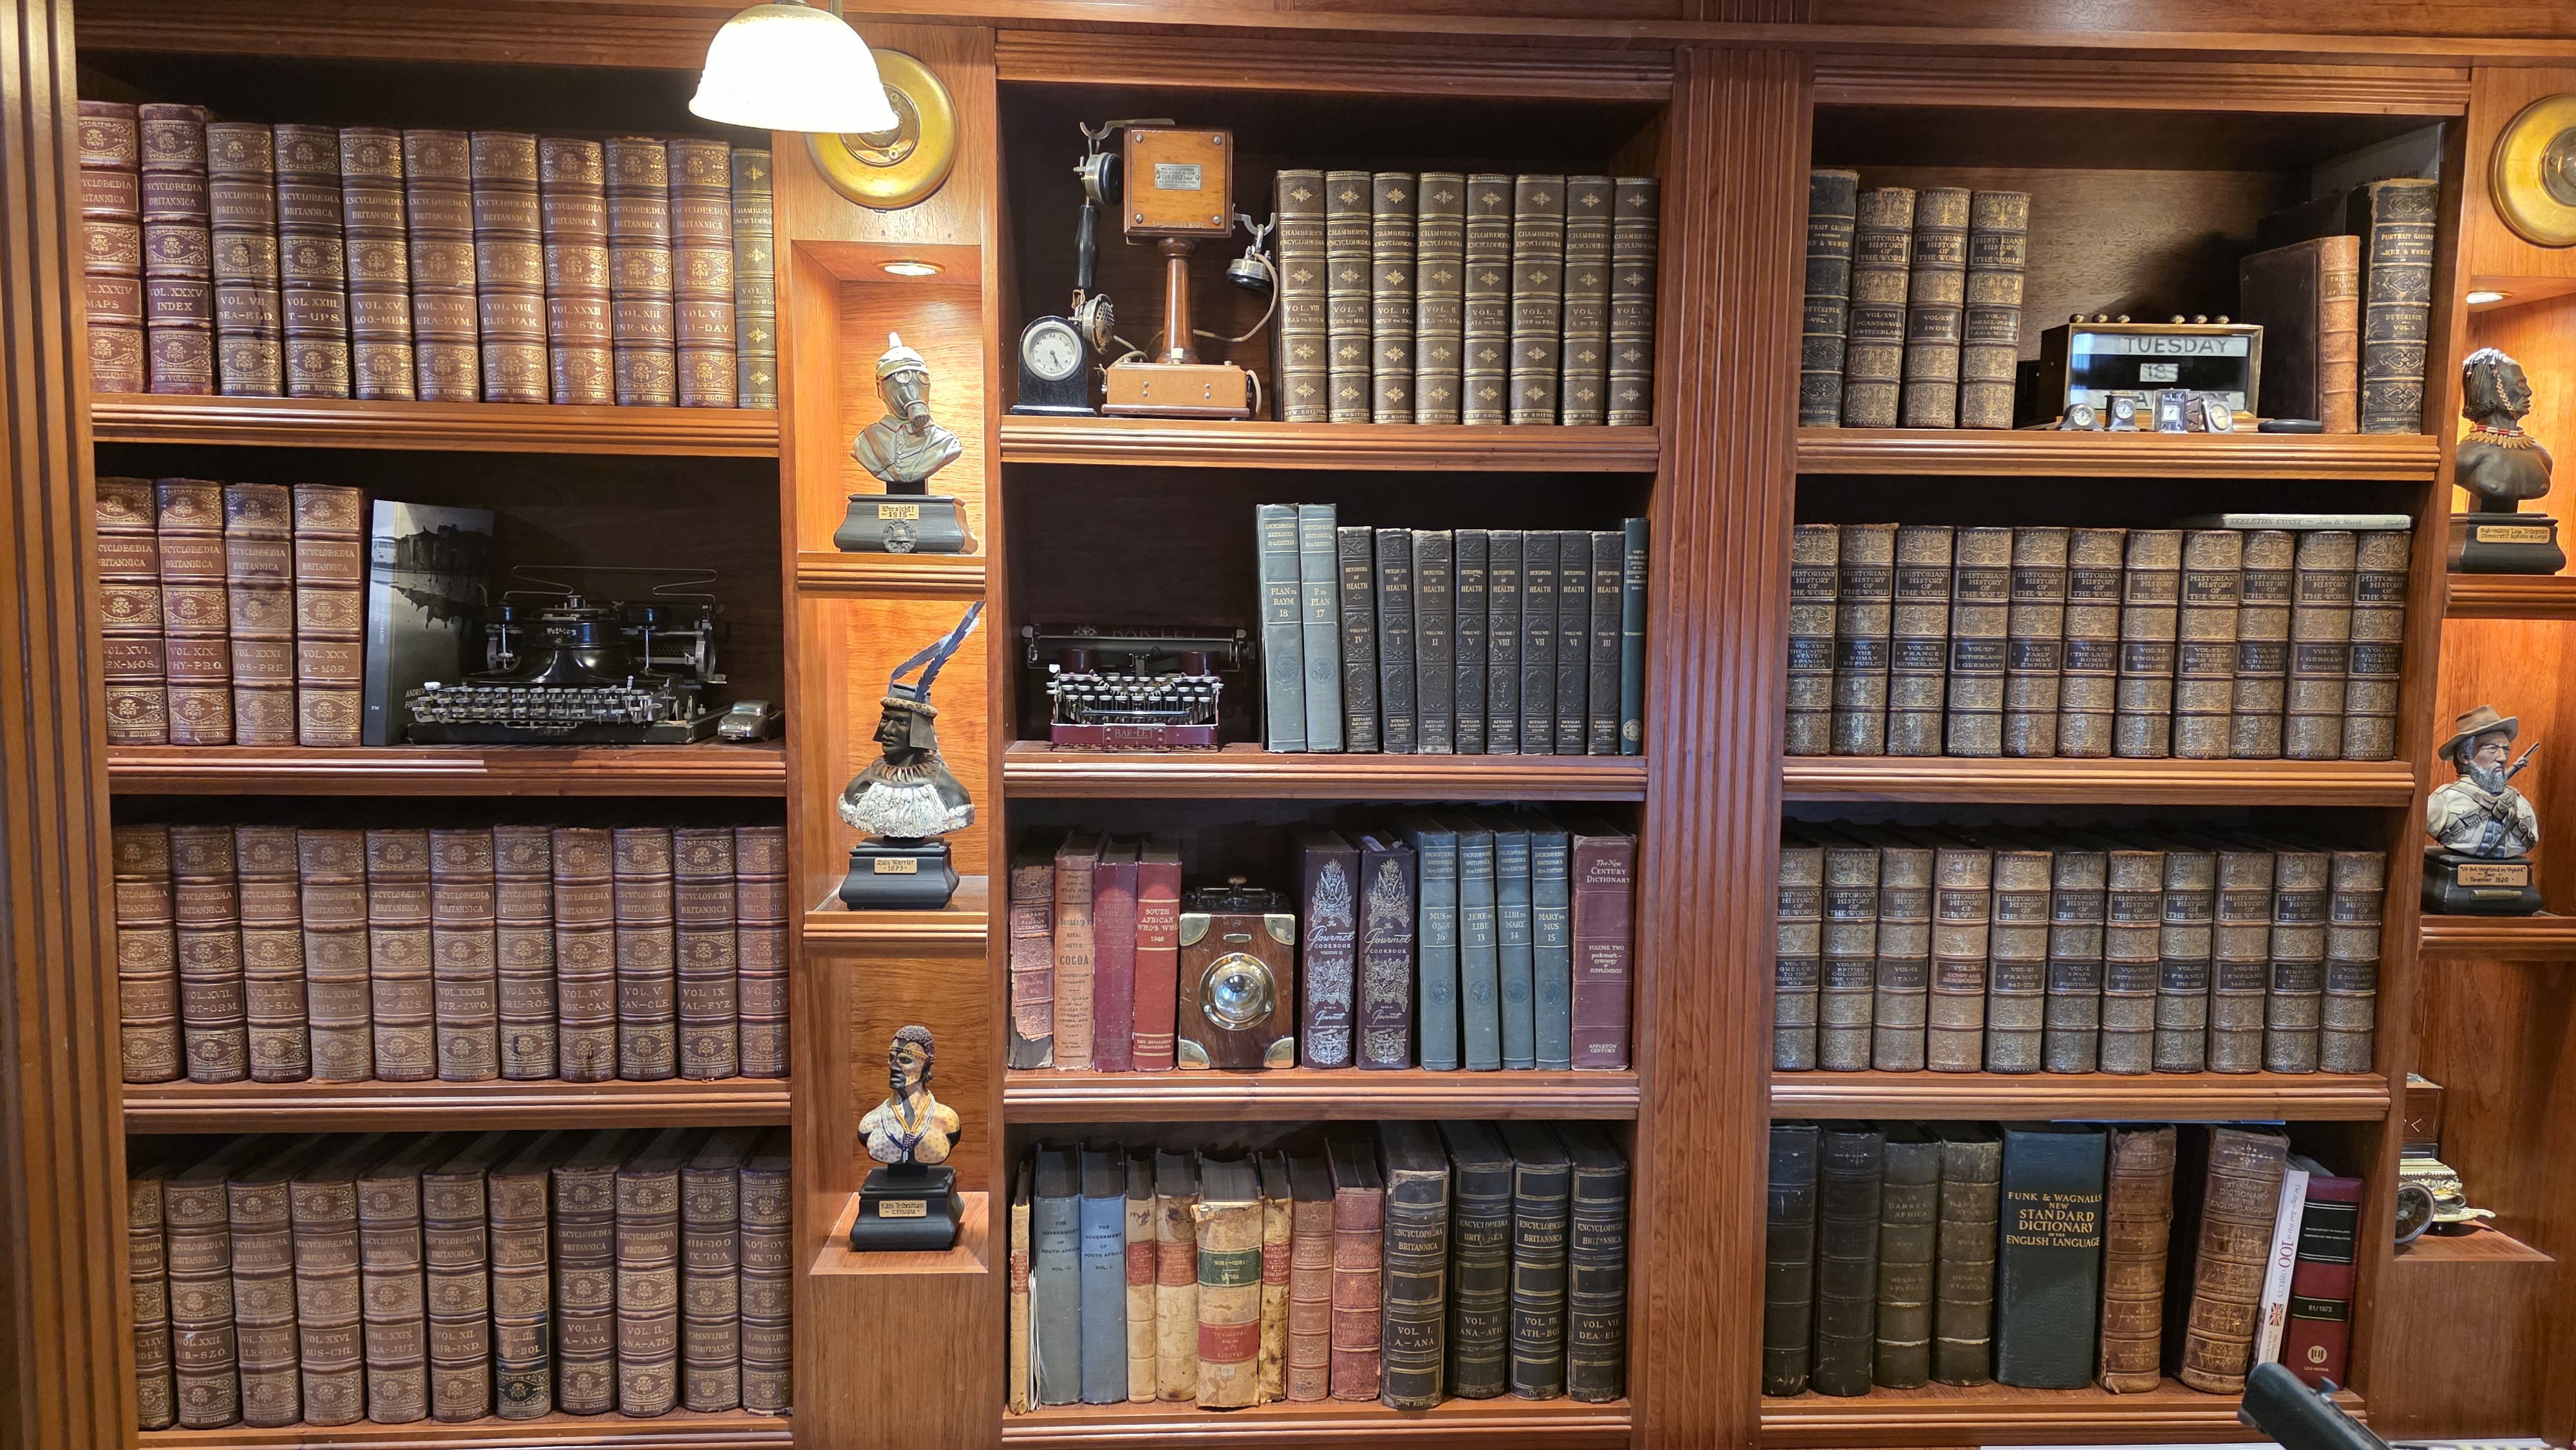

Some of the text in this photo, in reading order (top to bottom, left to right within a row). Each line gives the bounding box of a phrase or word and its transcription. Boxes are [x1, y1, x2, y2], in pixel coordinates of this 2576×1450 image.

[149, 197, 195, 207] BRITANNICA
[285, 207, 333, 217] BRITANNICA
[352, 211, 399, 221] BRITANNICA
[551, 218, 597, 227] BRITANNICA
[158, 301, 193, 311] INDEX
[2125, 338, 2229, 353] TUESDAY
[166, 560, 213, 569] BRITANNICA
[1115, 728, 1153, 738] BAR-LET
[375, 904, 419, 912] BRITANNICA
[681, 905, 727, 914] BRITANNICA
[1307, 926, 1355, 951] Gourmet
[1364, 928, 1412, 953] Gourmet
[1060, 956, 1088, 965] COCOA
[2008, 1192, 2038, 1201] FUNK
[2054, 1194, 2102, 1203] WAGNALLS
[2220, 1188, 2268, 1200] DICTIONARY
[2020, 1210, 2094, 1222] STANDARD
[2019, 1221, 2094, 1233] DICTIONARY
[1524, 1233, 1562, 1242] BRITANNICA
[2006, 1235, 2100, 1247] ENGLISH LANGUAGE
[1399, 1242, 1437, 1252] BRITANNICA
[2278, 1239, 2294, 1268] 100
[2277, 1270, 2287, 1297] OBJECTS
[627, 1327, 651, 1335] VOL.
